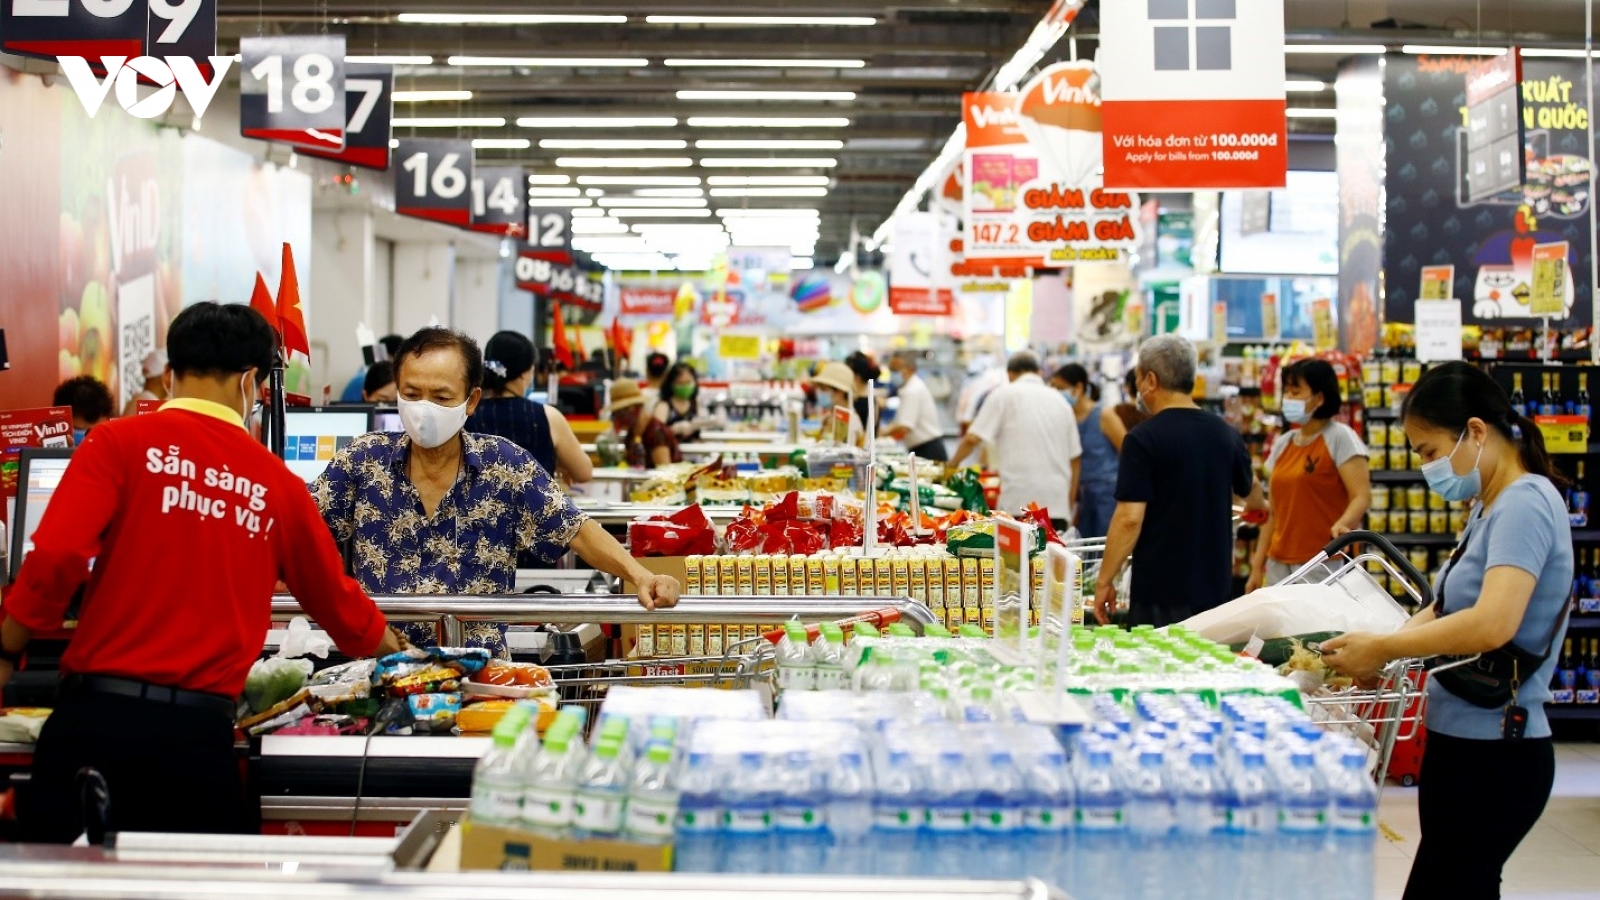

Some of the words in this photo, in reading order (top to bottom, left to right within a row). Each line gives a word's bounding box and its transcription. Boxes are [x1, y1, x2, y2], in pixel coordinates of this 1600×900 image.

[251, 53, 335, 114] 18
[403, 152, 467, 198] 16
[1125, 152, 1152, 162] Apply
[1154, 151, 1167, 161] for
[1189, 151, 1209, 161] from
[471, 177, 519, 217] 14
[528, 213, 566, 247] 12
[34, 421, 69, 439] VinID
[146, 445, 196, 480] Sẵn
[204, 465, 268, 511] sàng
[161, 481, 226, 521] phục
